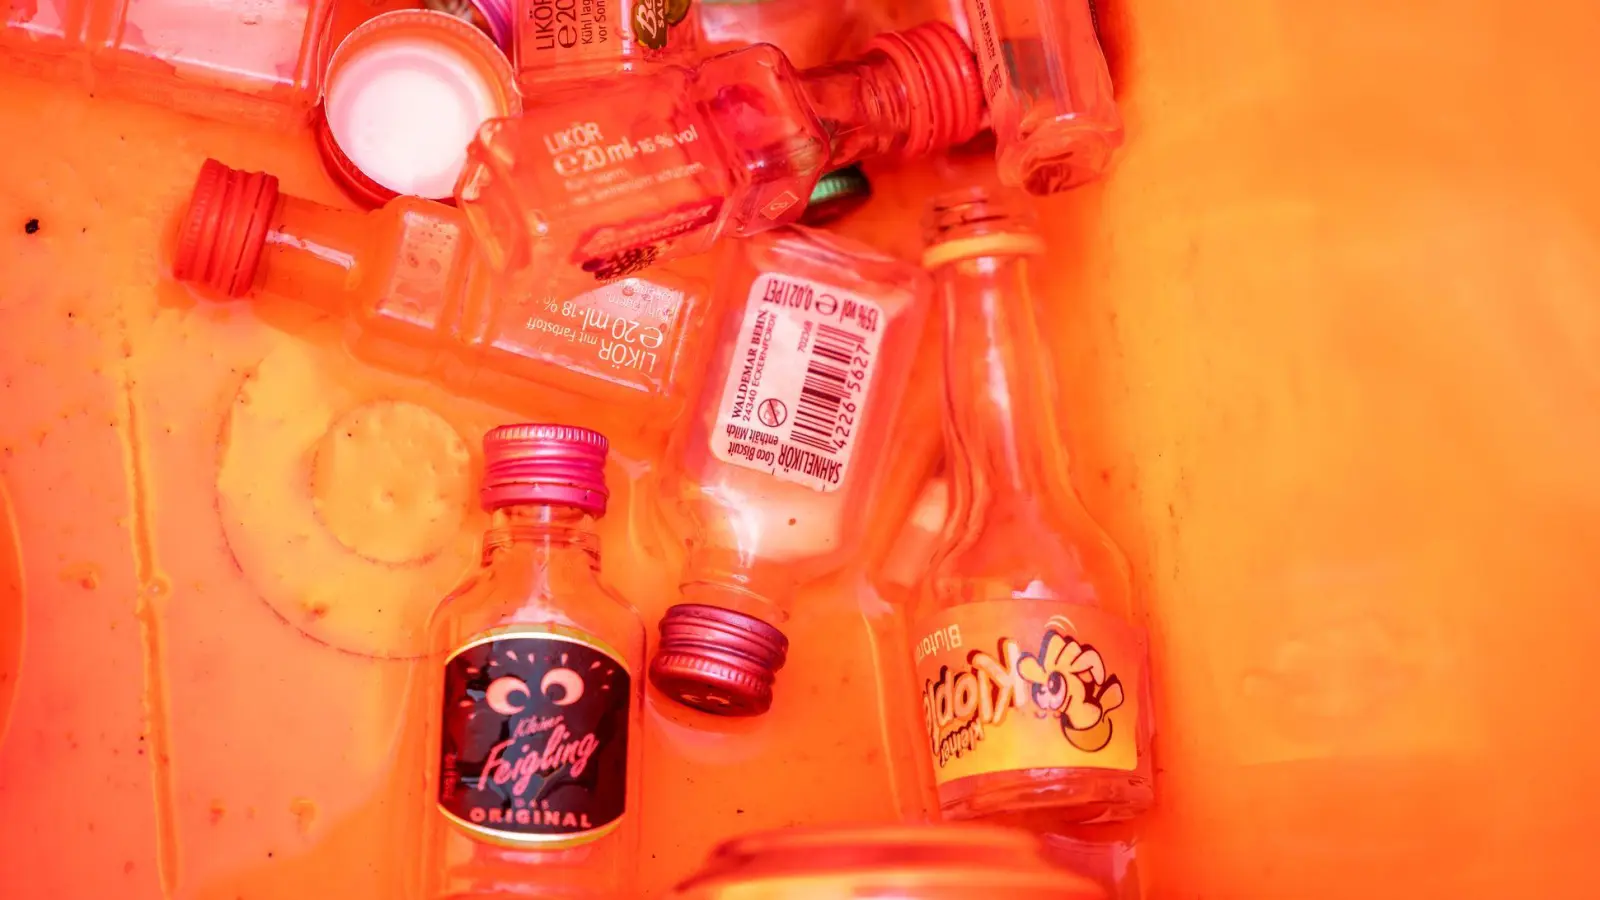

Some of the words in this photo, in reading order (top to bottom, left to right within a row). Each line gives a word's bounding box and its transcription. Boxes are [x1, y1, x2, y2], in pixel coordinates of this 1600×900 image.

[594, 0, 607, 23] Son
[581, 18, 593, 45] Kühl
[598, 26, 607, 43] vor
[576, 145, 607, 172] 20
[674, 123, 699, 144] vol
[527, 317, 576, 342] Farbstoff
[579, 331, 598, 345] mit
[611, 317, 640, 343] 20
[598, 338, 657, 373] LIKÖR
[732, 348, 757, 419] WALDEMAR
[751, 310, 767, 345] BEHN
[743, 389, 757, 422] 24340
[832, 402, 856, 449] 4226
[847, 344, 870, 393] 5627
[726, 424, 749, 440] Milch
[749, 429, 779, 446] enthält
[728, 441, 755, 461] Biscuit
[756, 449, 775, 466] Coco
[778, 444, 842, 484] SAHNELIKÖR
[478, 724, 599, 796] Feigling
[470, 807, 592, 828] ORIGINAL
